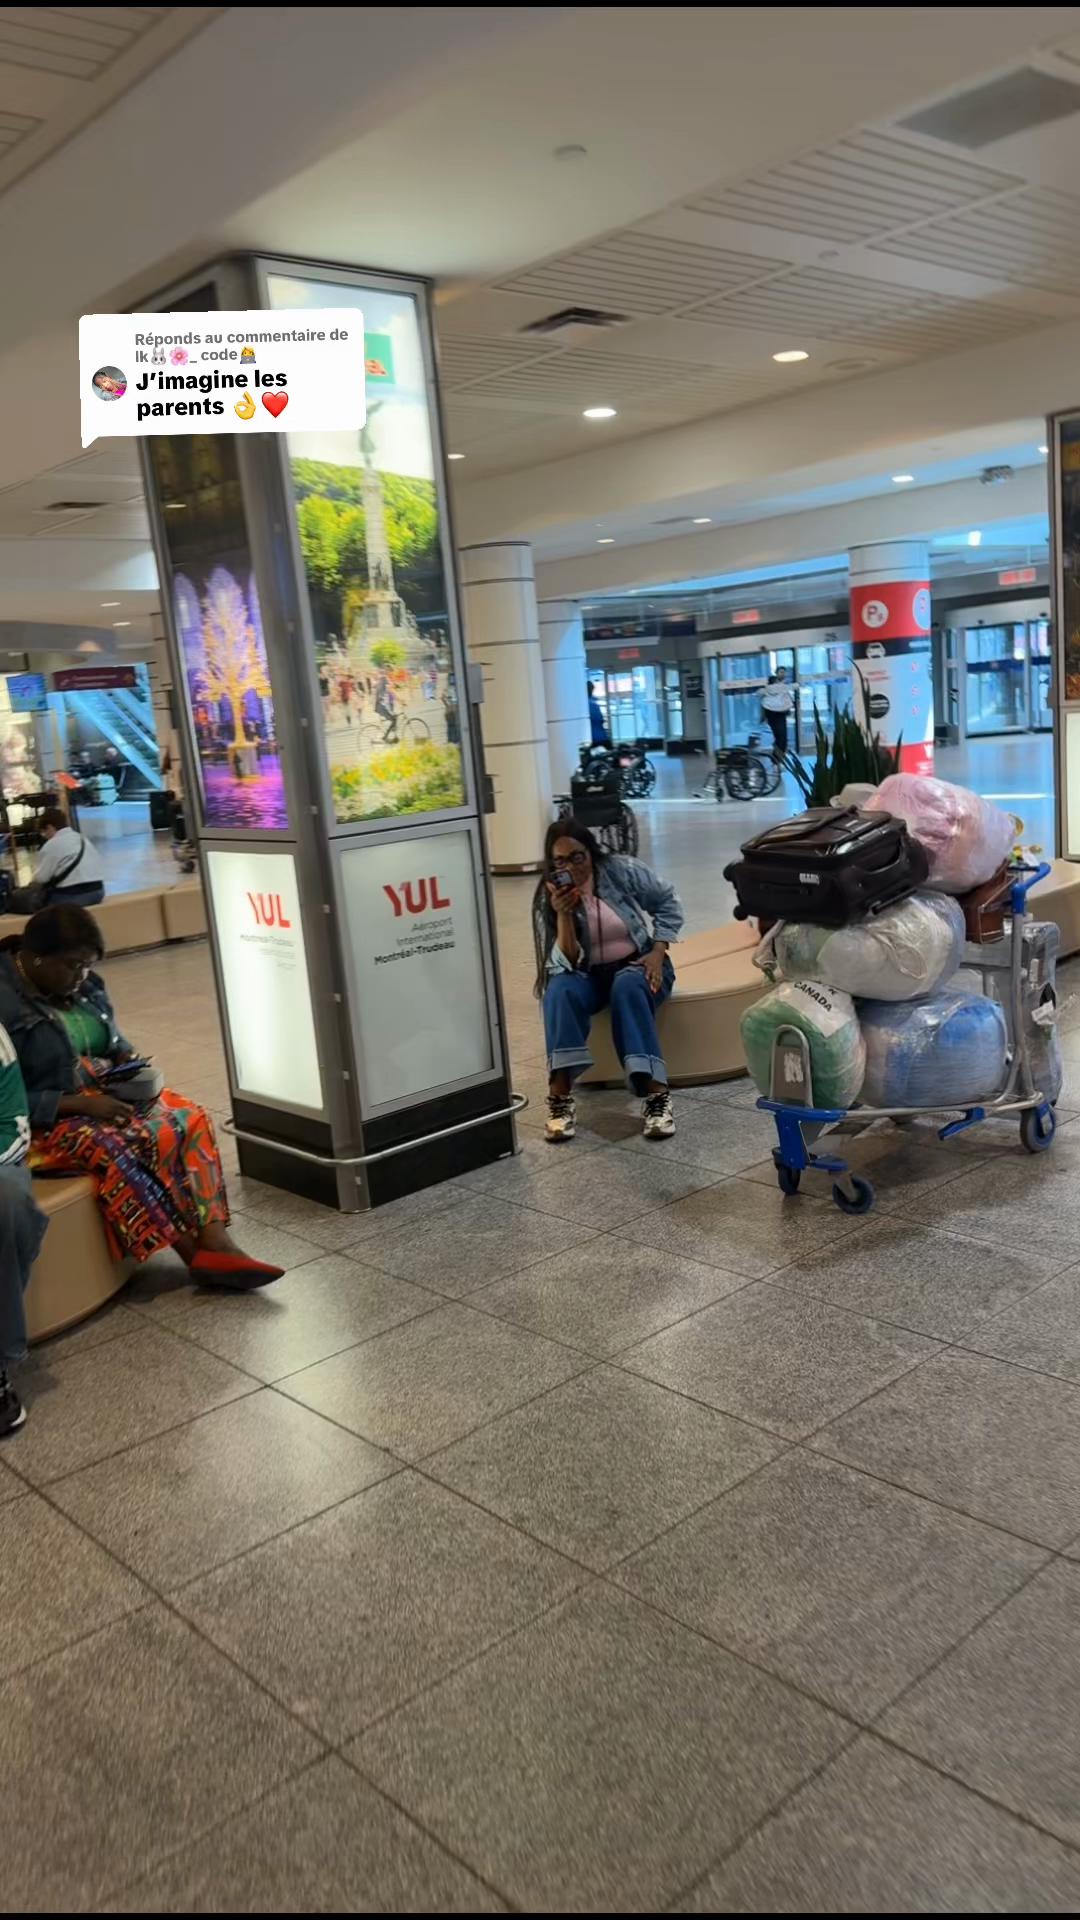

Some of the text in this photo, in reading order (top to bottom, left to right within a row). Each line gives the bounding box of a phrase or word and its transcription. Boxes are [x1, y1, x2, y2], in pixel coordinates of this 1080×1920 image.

[247, 891, 291, 928] YUL
[382, 876, 451, 917] YUL
[794, 981, 832, 1012] CANADA
